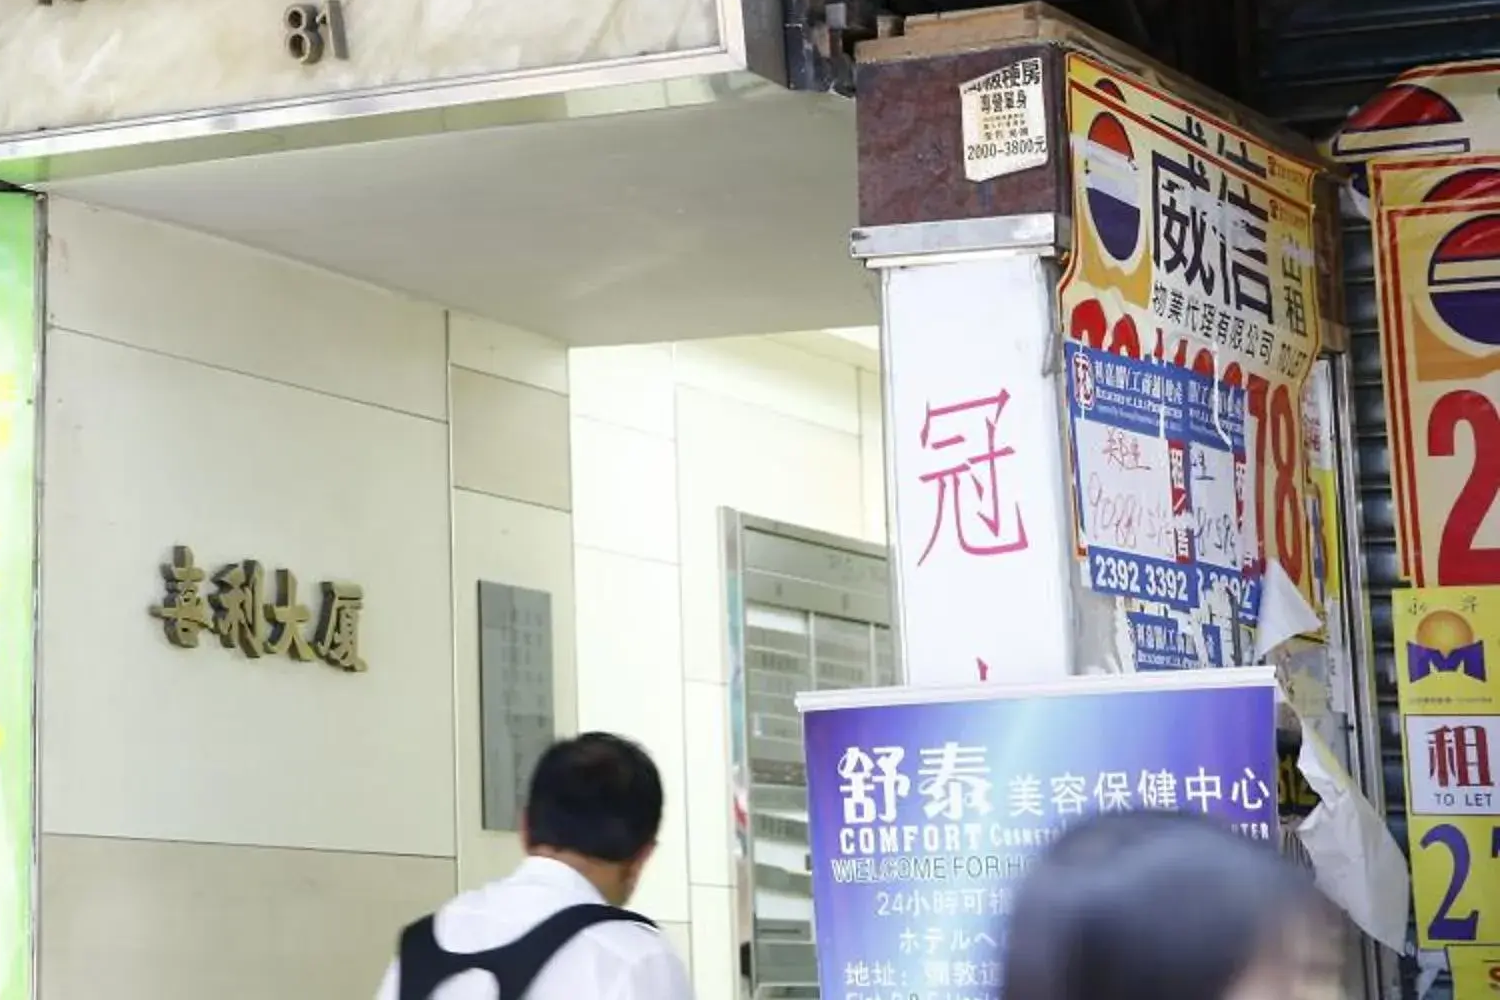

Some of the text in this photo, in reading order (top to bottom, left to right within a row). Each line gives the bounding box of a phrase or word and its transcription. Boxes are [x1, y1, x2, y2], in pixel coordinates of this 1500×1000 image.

[283, 0, 349, 64] 81
[1095, 554, 1189, 601] 2392 3392
[1428, 725, 1495, 789] 租
[838, 741, 993, 825] 舒泰
[1007, 766, 1270, 816] 美容保健中心
[1434, 792, 1492, 808] TO LET
[840, 822, 983, 856] COMFORT
[831, 857, 947, 884] WELCOME
[954, 856, 1000, 879] FOR
